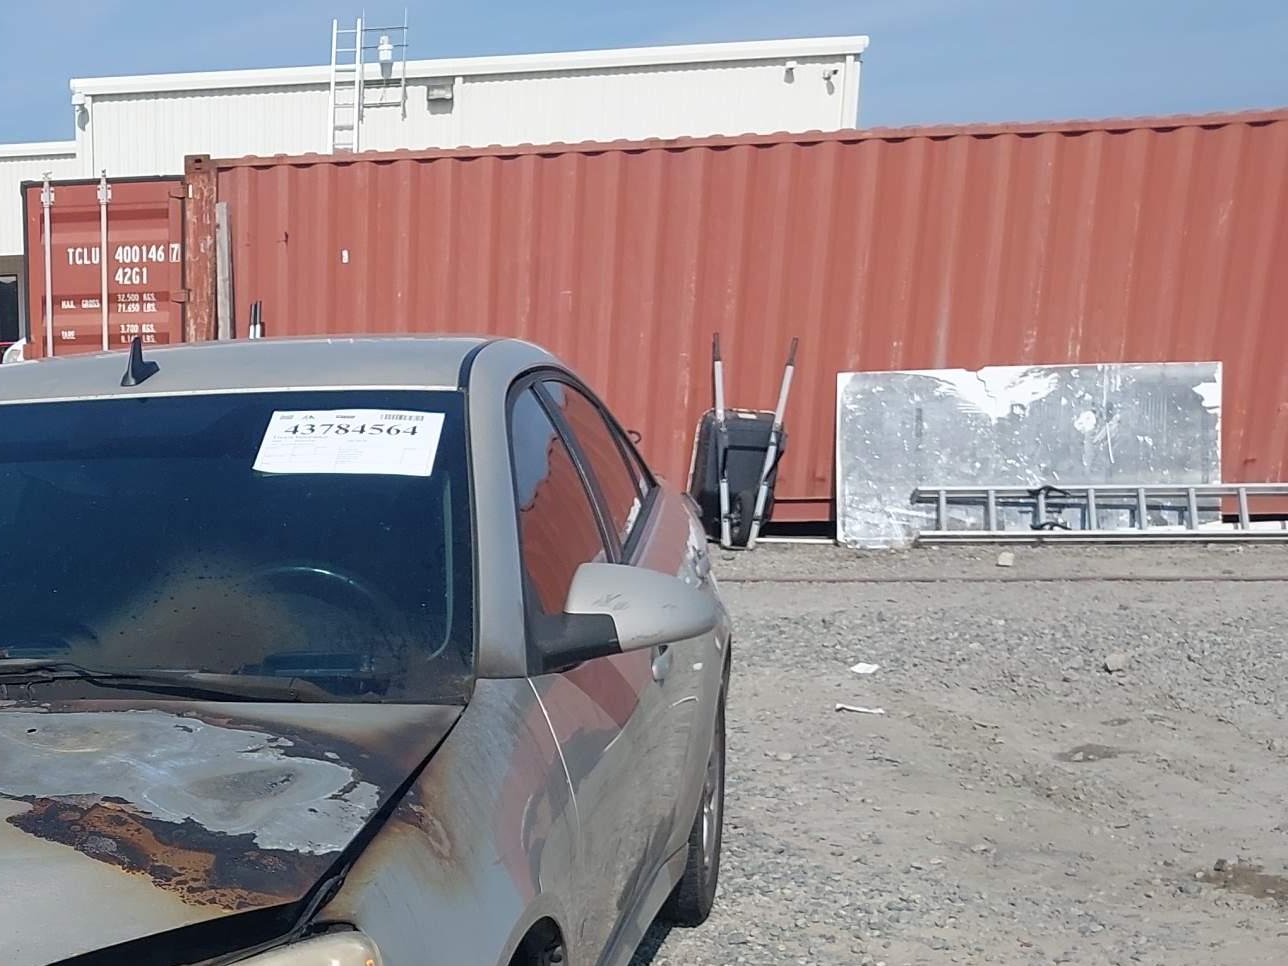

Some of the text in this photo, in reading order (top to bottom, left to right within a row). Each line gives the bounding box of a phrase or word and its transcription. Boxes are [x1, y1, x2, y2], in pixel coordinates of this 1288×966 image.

[67, 243, 181, 265] TCLU 400146 7
[114, 267, 148, 285] 42G1
[284, 423, 418, 436] 43784564
